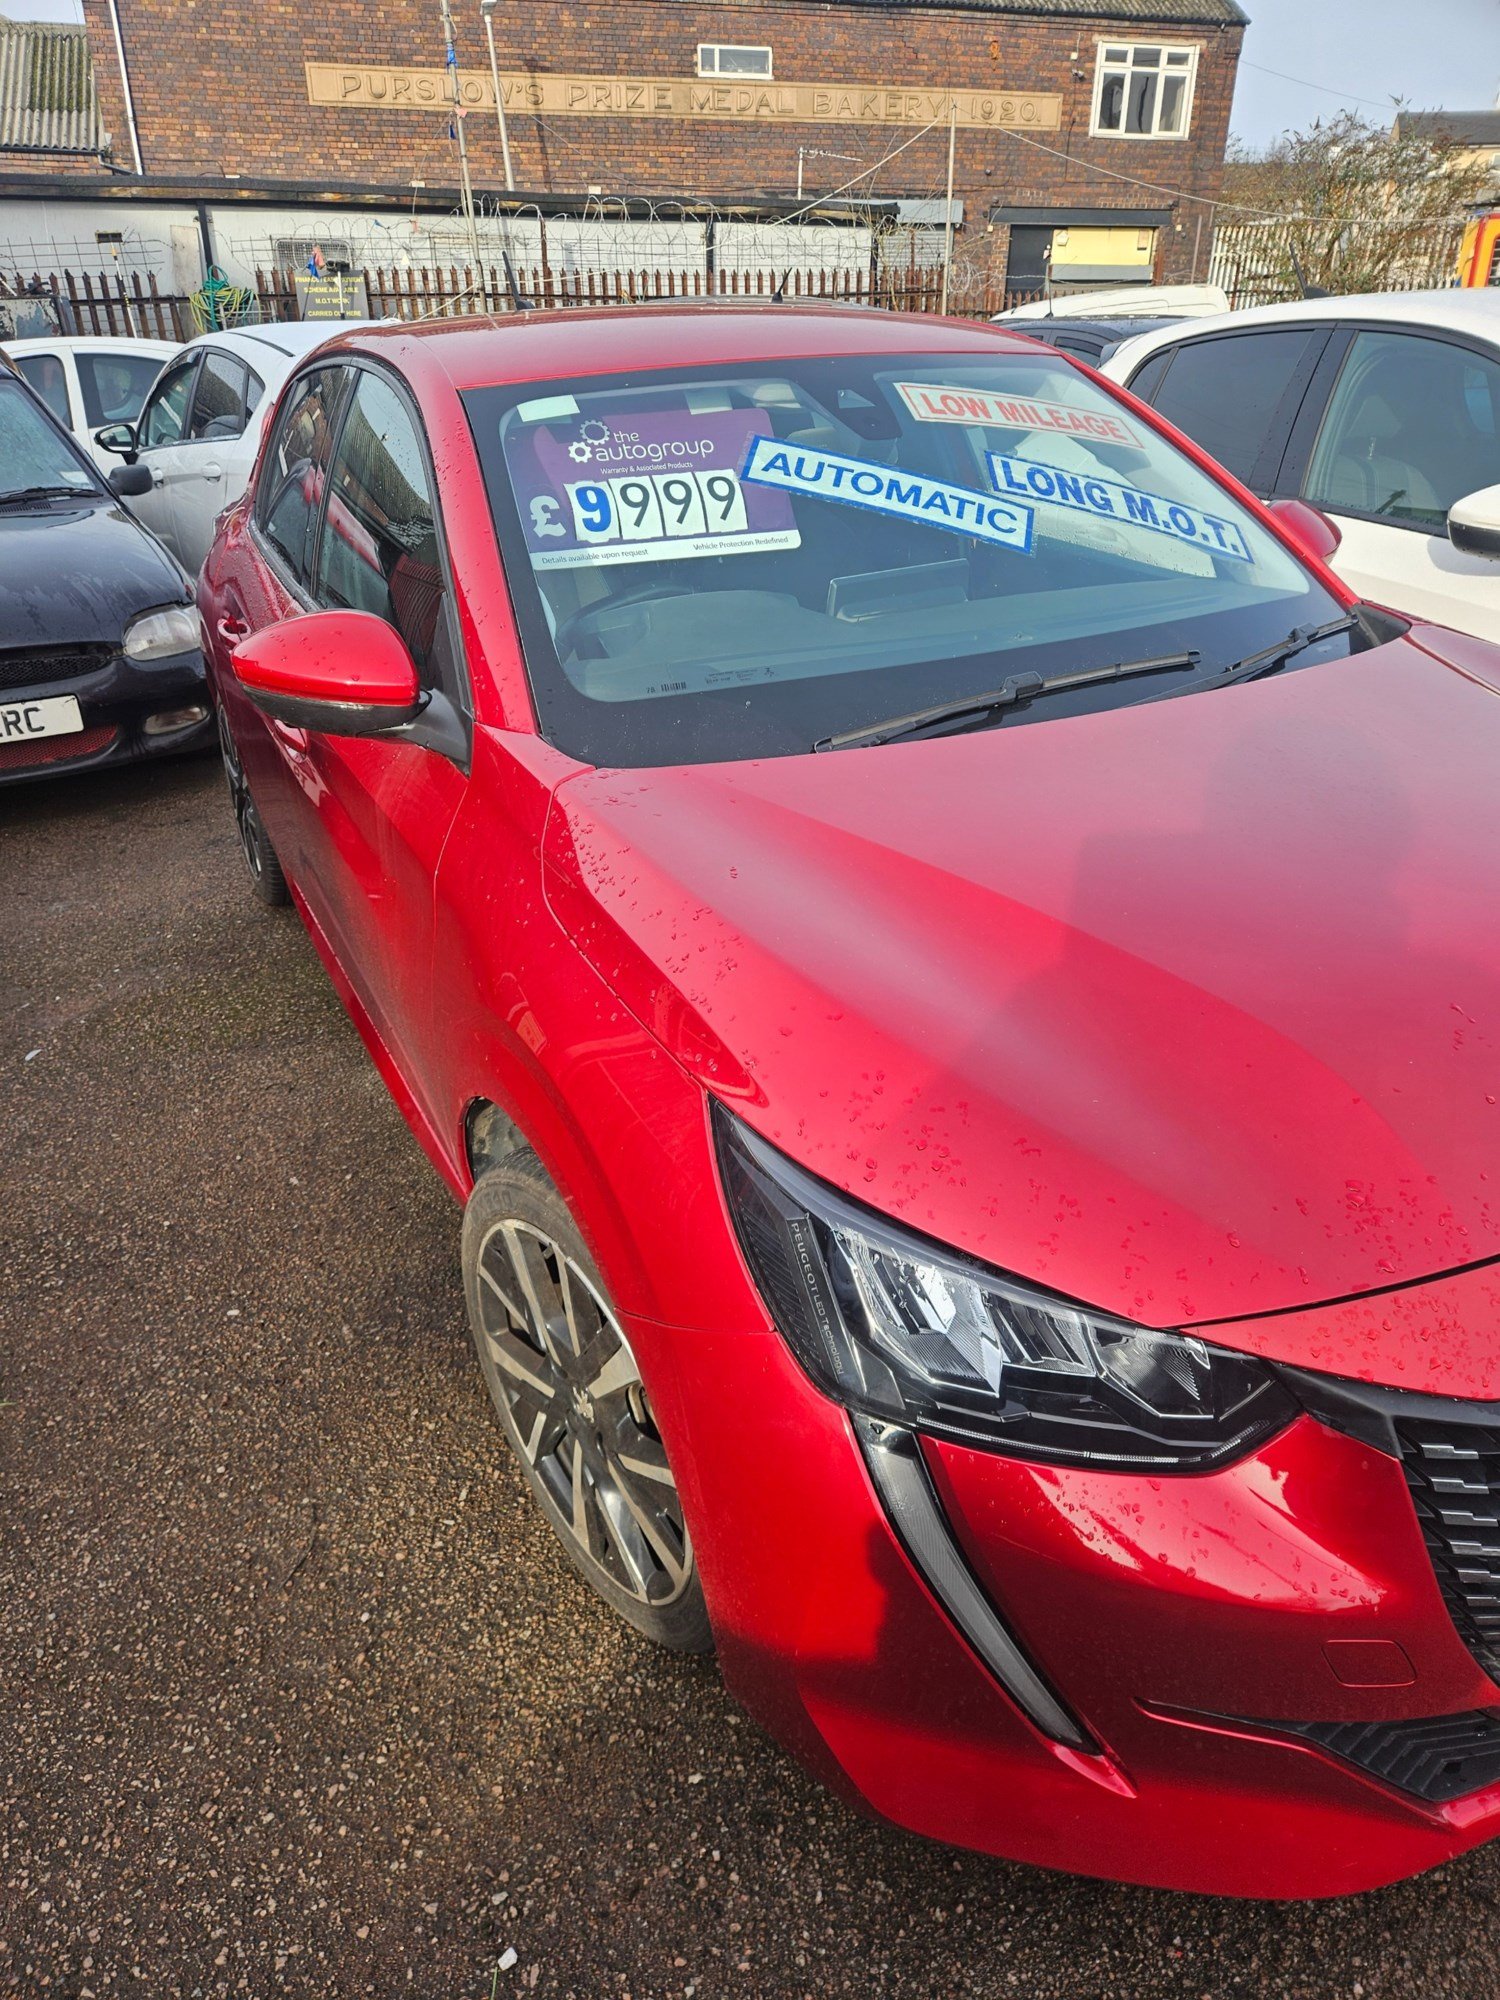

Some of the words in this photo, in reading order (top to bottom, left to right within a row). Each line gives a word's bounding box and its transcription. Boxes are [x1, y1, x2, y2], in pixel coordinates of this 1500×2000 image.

[341, 75, 545, 105] PURSLOW'S
[568, 83, 673, 110] PRIZE
[689, 87, 795, 114] MEDAL
[970, 97, 1042, 121] 1920.
[919, 392, 993, 420] LOW
[993, 400, 1129, 441] MILEAGE
[595, 439, 714, 462] autogroup
[613, 430, 640, 443] the
[600, 466, 629, 475] Warranty
[636, 462, 667, 472] Associated
[667, 461, 693, 469] Products
[761, 452, 1018, 534] AUTOMATIC
[1000, 459, 1115, 514] LONG
[1121, 490, 1241, 554] M.O.T.
[541, 556, 567, 564] Details
[568, 553, 600, 562] available
[601, 550, 621, 559] upon
[621, 548, 649, 557] request
[693, 542, 718, 551] Vehicle
[719, 539, 754, 549] Protection
[755, 536, 789, 545] Redefined
[0, 706, 45, 737] RC
[791, 1222, 819, 1291] PEUGEOT
[814, 1294, 826, 1317] LED
[820, 1316, 845, 1376] Technology
